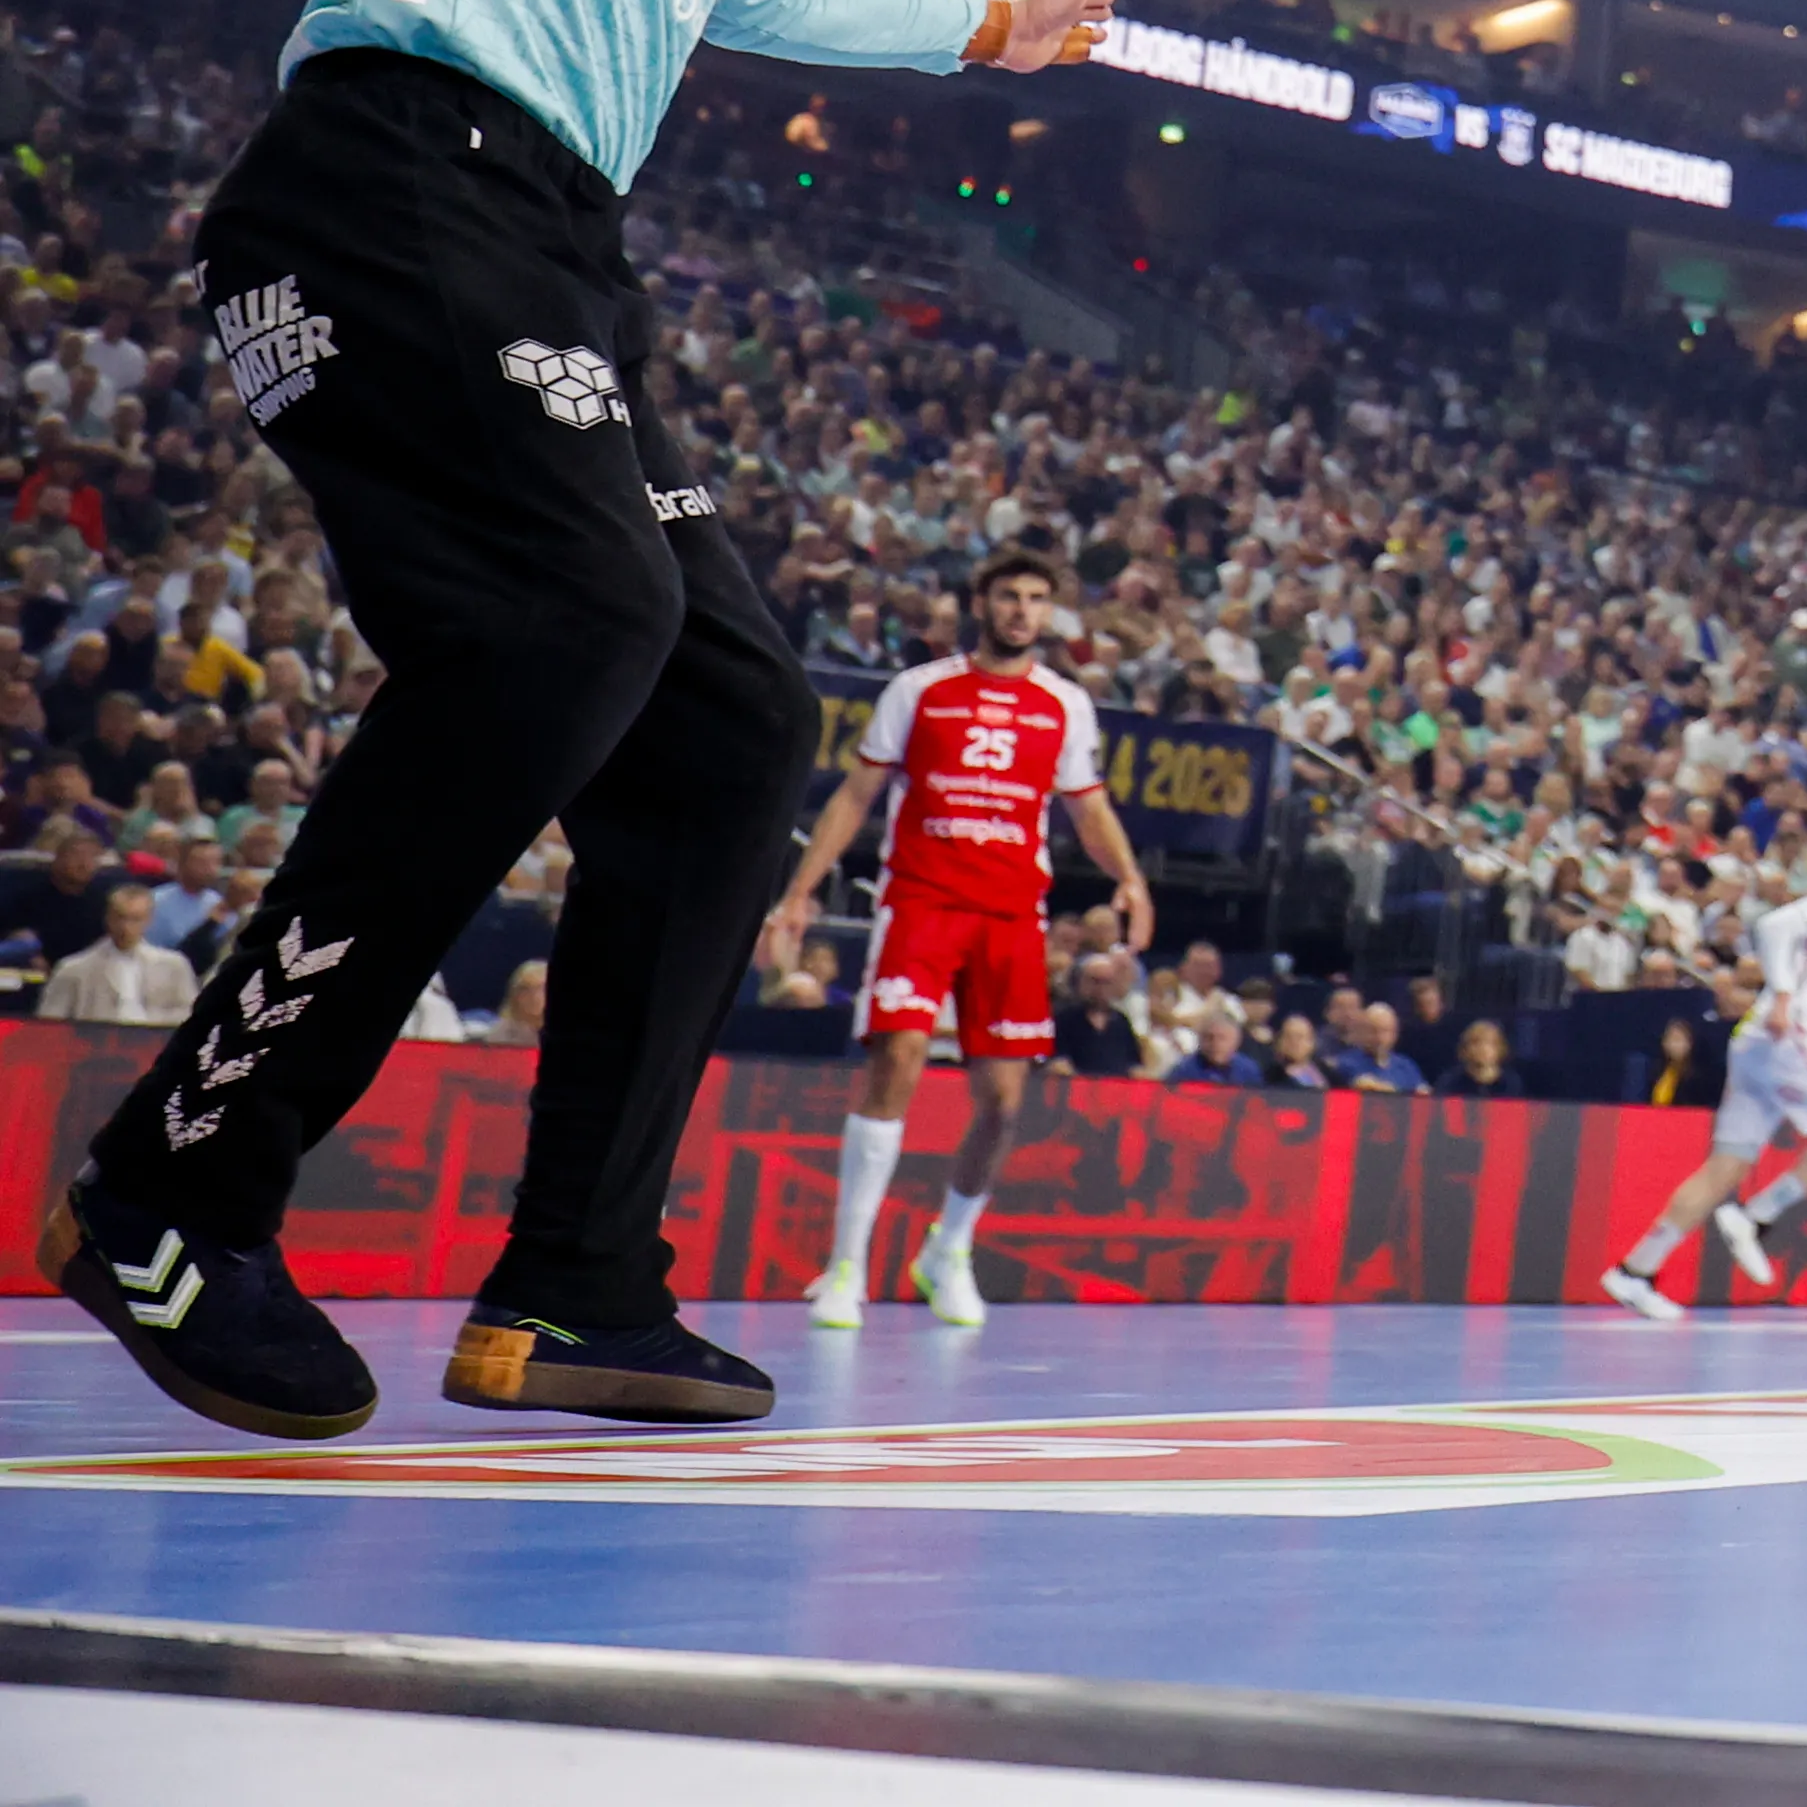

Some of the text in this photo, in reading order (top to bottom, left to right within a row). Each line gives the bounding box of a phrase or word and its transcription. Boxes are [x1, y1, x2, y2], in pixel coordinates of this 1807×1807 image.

[214, 274, 305, 355] BLUE
[228, 315, 340, 406] WATER
[959, 725, 1018, 771] 25
